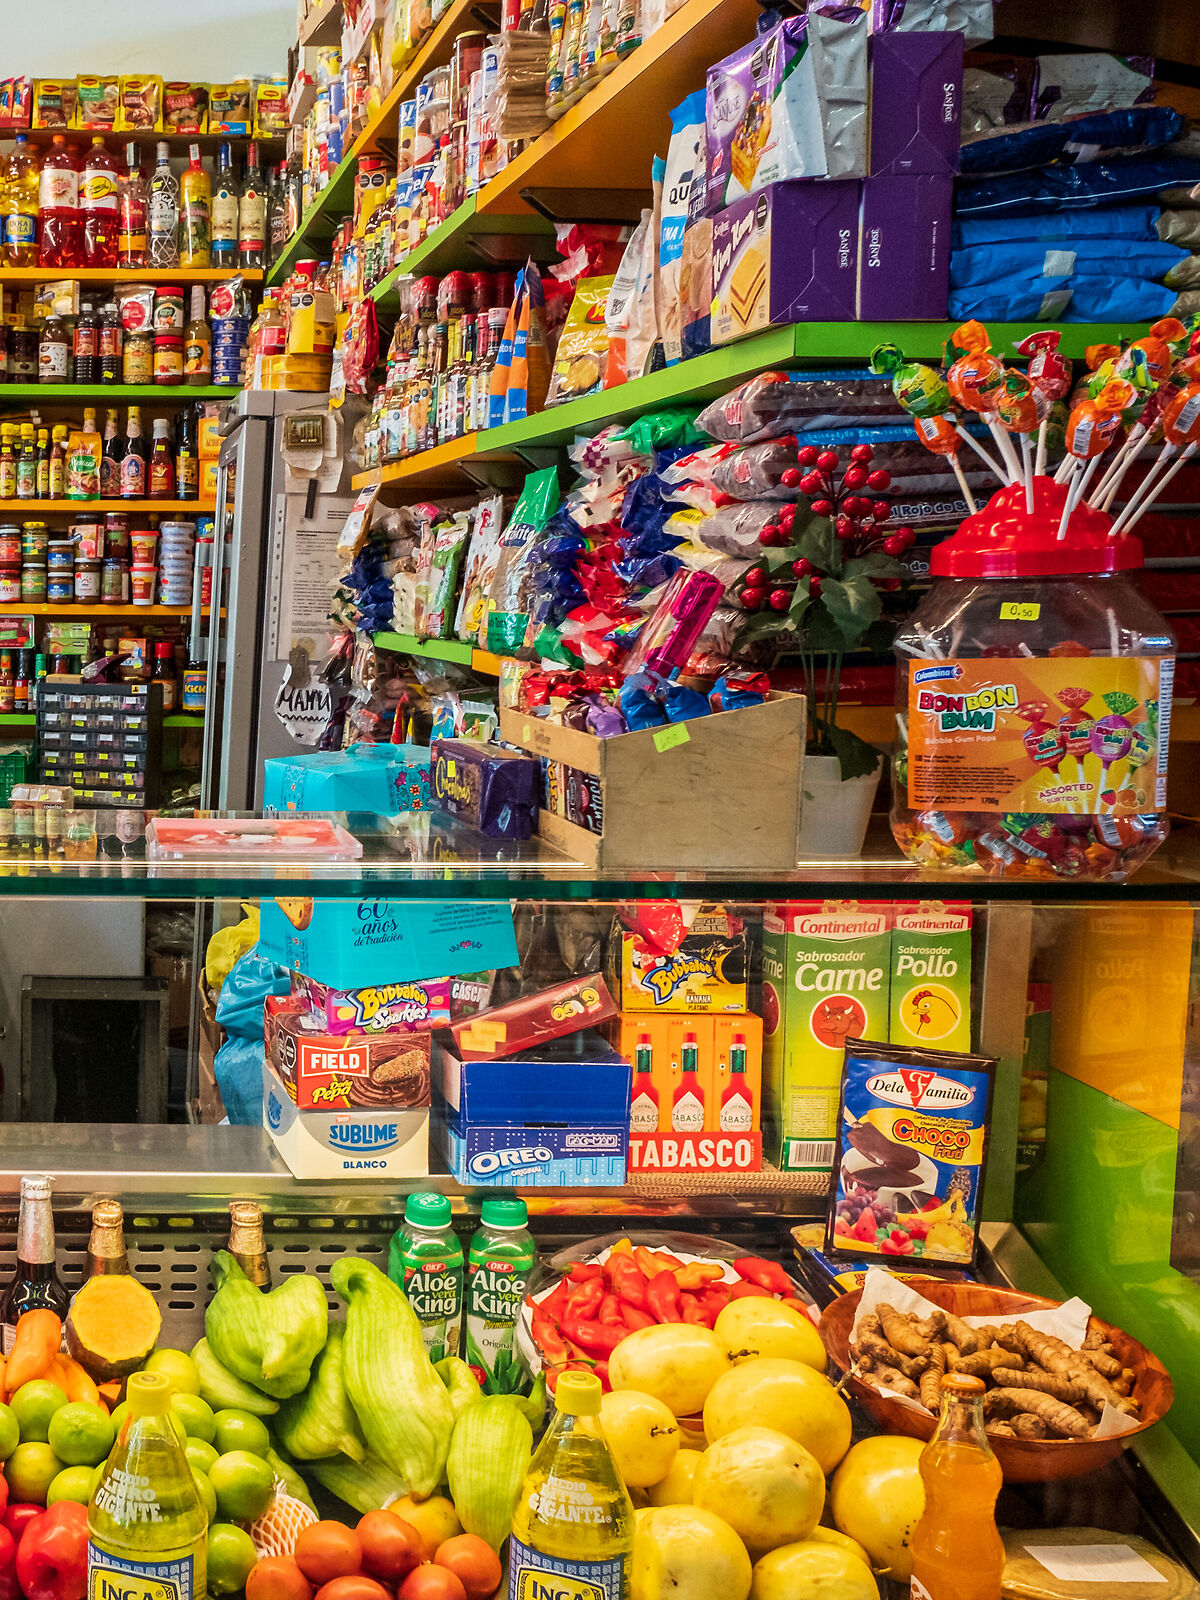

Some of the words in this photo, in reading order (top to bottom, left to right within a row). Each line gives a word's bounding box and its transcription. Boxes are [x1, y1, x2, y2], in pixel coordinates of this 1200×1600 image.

[902, 503, 931, 516] Rojo
[936, 501, 951, 511] de
[916, 669, 950, 681] Colombina
[919, 691, 964, 712] BON
[966, 686, 1016, 712] BON
[941, 711, 994, 731] BUM
[925, 737, 953, 745] Bubble
[976, 735, 997, 743] Pops
[1039, 783, 1094, 799] ASSORTED
[361, 918, 399, 936] años
[800, 918, 882, 935] Continental
[901, 915, 964, 931] Continental
[796, 950, 865, 962] Sabrosador
[898, 945, 953, 956] Sabrosador
[653, 959, 711, 993] Bubbaloo
[896, 955, 958, 979] Pollo
[795, 962, 883, 992] Carne
[356, 983, 427, 1020] Bubbaloo
[371, 1003, 429, 1029] Sparkies
[311, 1053, 360, 1069] FIELD
[312, 1084, 352, 1103] Pepa
[909, 1071, 969, 1101] Familia
[329, 1124, 398, 1144] SUBLIME
[893, 1118, 970, 1148] CHOCO
[629, 1139, 751, 1168] TABASCO
[933, 1144, 964, 1160] Fruti
[343, 1160, 387, 1169] BLANCO
[471, 1149, 552, 1174] OREO
[511, 1166, 543, 1177] ORIGINAL
[425, 1263, 442, 1271] OKF
[490, 1262, 509, 1271] OKF
[407, 1273, 457, 1293] Aloe
[471, 1270, 526, 1295] Aloe
[432, 1290, 456, 1299] vera
[409, 1294, 456, 1315] King
